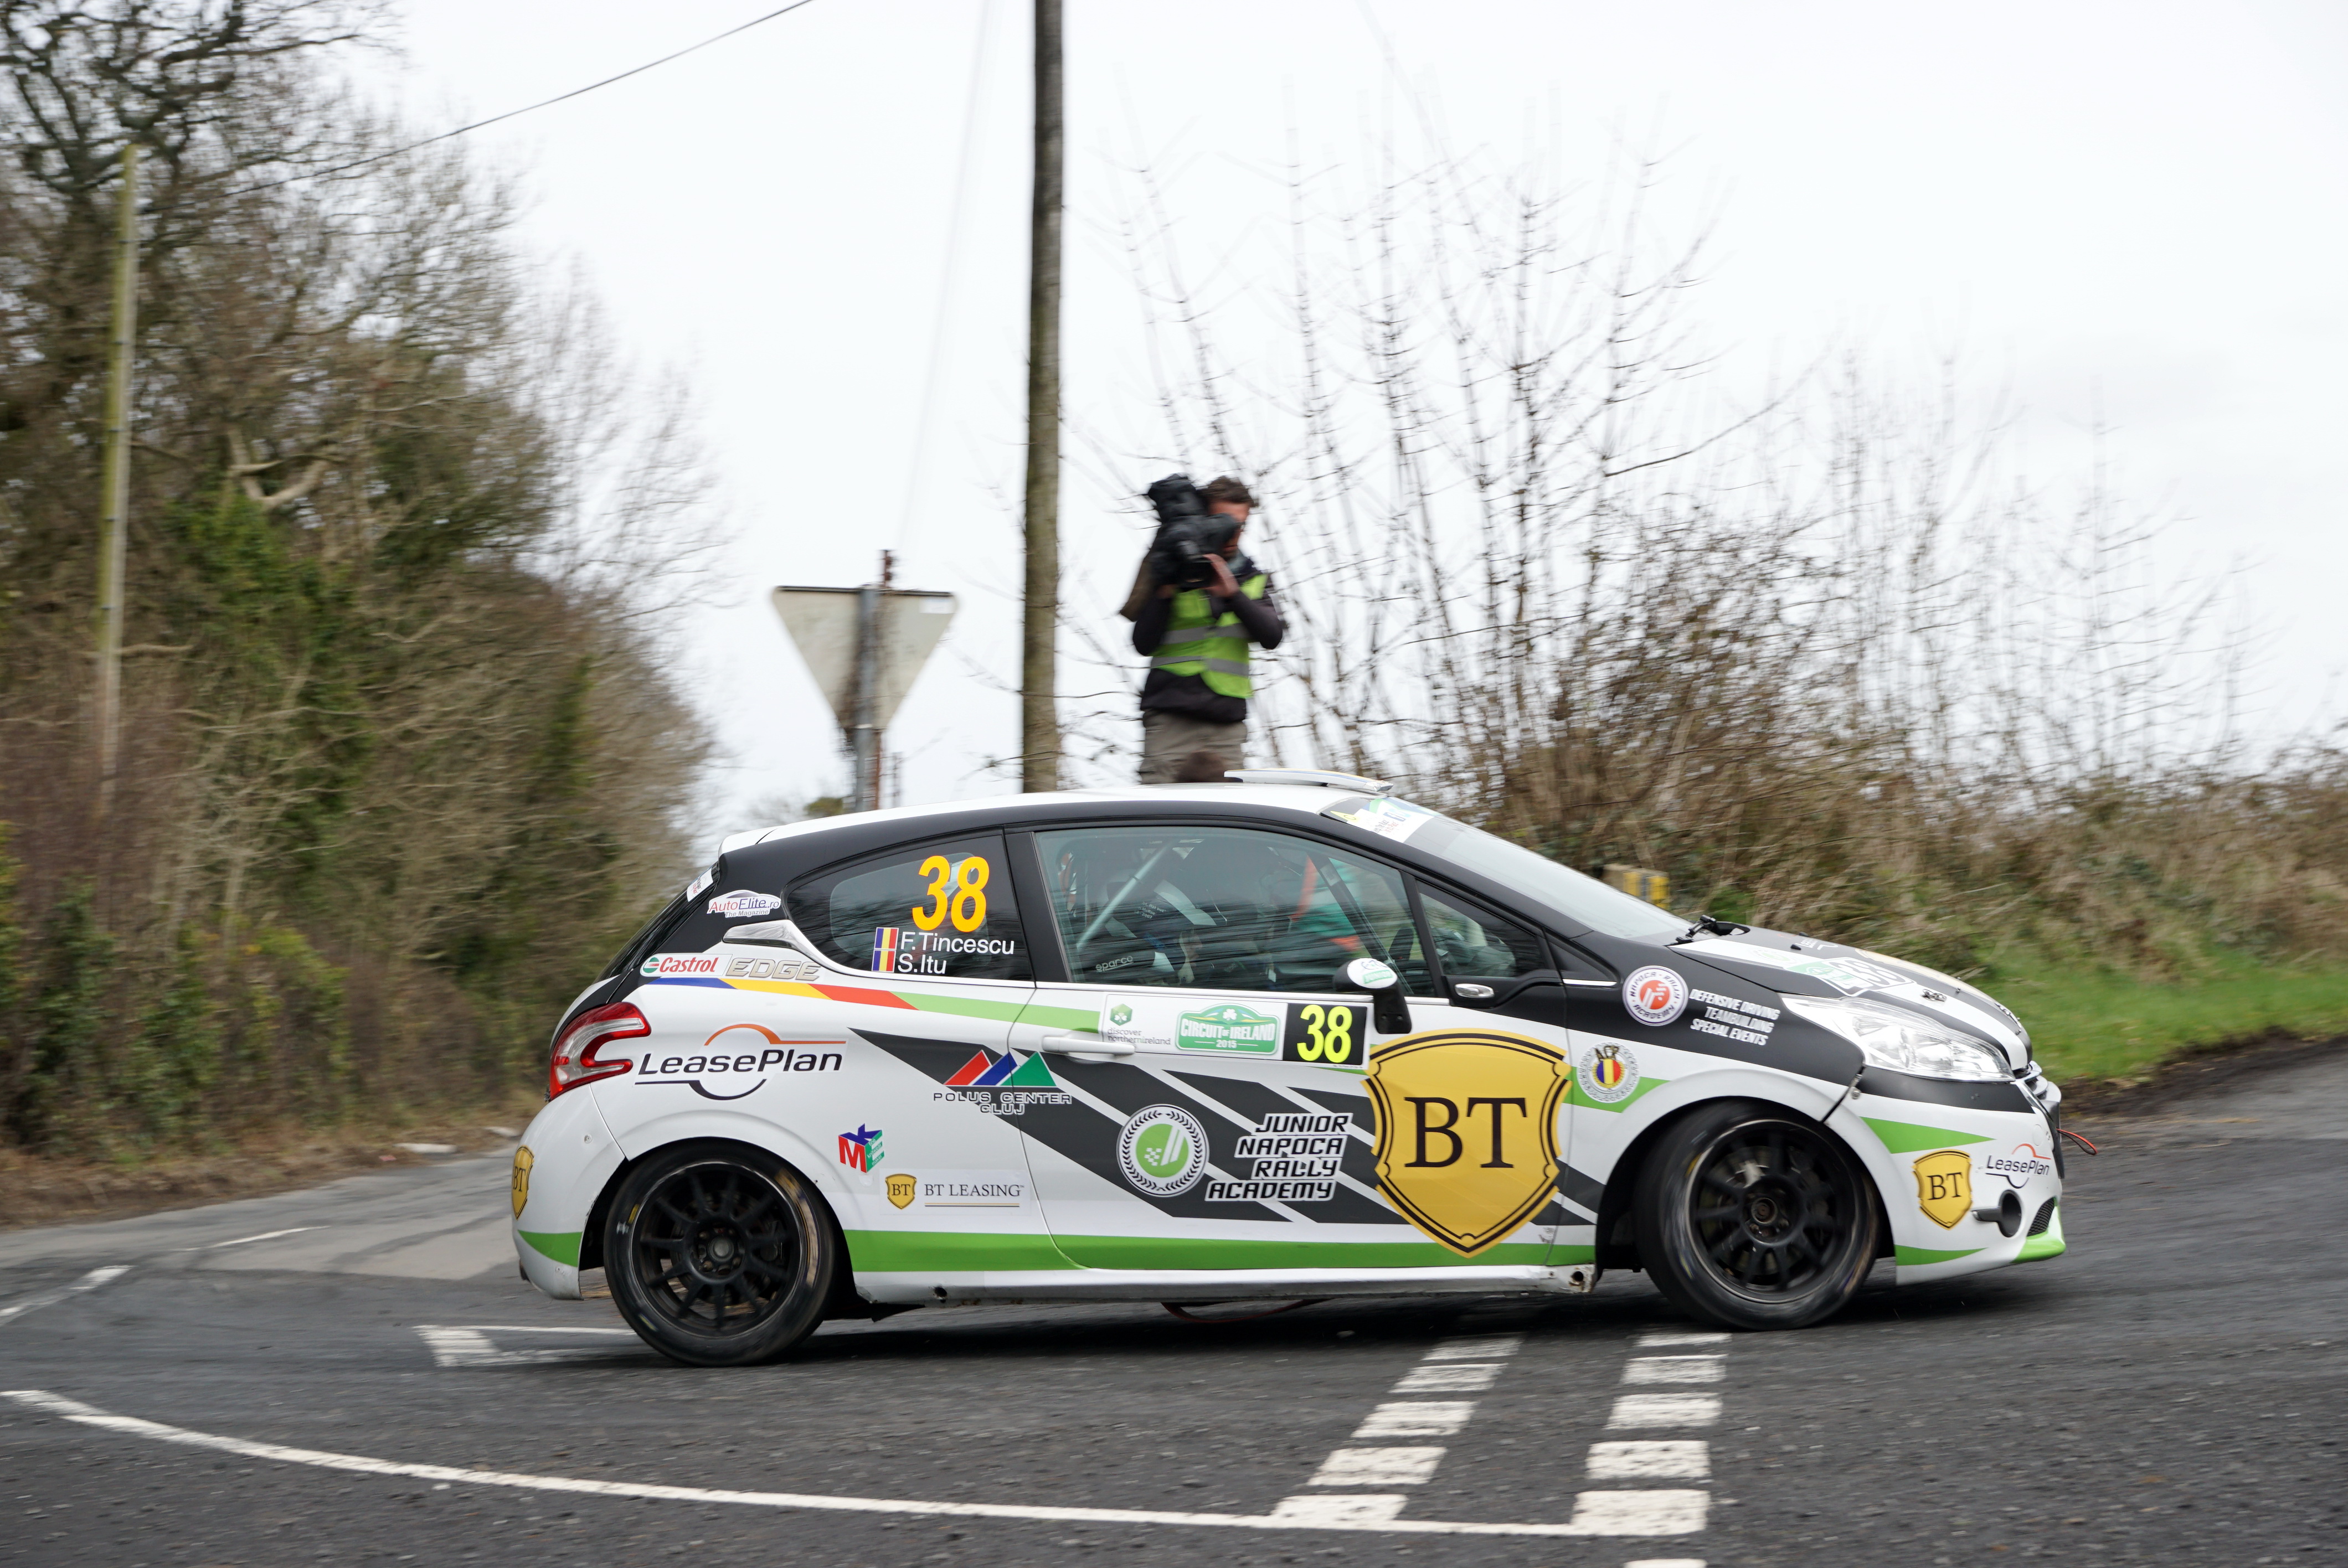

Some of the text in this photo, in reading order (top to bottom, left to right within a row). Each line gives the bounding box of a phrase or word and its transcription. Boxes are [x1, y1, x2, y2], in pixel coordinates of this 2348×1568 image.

[912, 855, 990, 932] 38
[709, 898, 779, 912] AutoElite.ro
[900, 931, 1015, 955] F.Tincescu
[660, 957, 821, 981] Castrol EDGE
[898, 953, 947, 974] S.Itu
[1095, 956, 1133, 972] sparco
[1828, 960, 1906, 986] 38
[1688, 989, 1781, 1020] DEFENSIVE DRIVING
[1108, 1028, 1142, 1036] discover
[1180, 1018, 1224, 1038] CIRCUIT
[1229, 1023, 1275, 1041] IRELAND
[1296, 1004, 1353, 1064] 38
[1690, 1018, 1769, 1046] SPECIAL EVENTS
[1216, 1039, 1237, 1048] 2015
[638, 1049, 843, 1075] LeasePlan
[934, 1092, 1072, 1104] POLUS CENTER
[980, 1103, 1025, 1115] CLUJ
[1254, 1115, 1350, 1133] JUNIOR
[1404, 1096, 1528, 1168] BT
[1238, 1138, 1341, 1156] NAPOCA
[1255, 1159, 1337, 1178] RALLY
[1986, 1155, 2050, 1175] LeasePlan
[513, 1165, 526, 1192] BT
[1925, 1172, 1964, 1200] BT
[891, 1184, 911, 1196] BT
[924, 1184, 944, 1196] BT
[1208, 1182, 1334, 1199] ACADEMY
